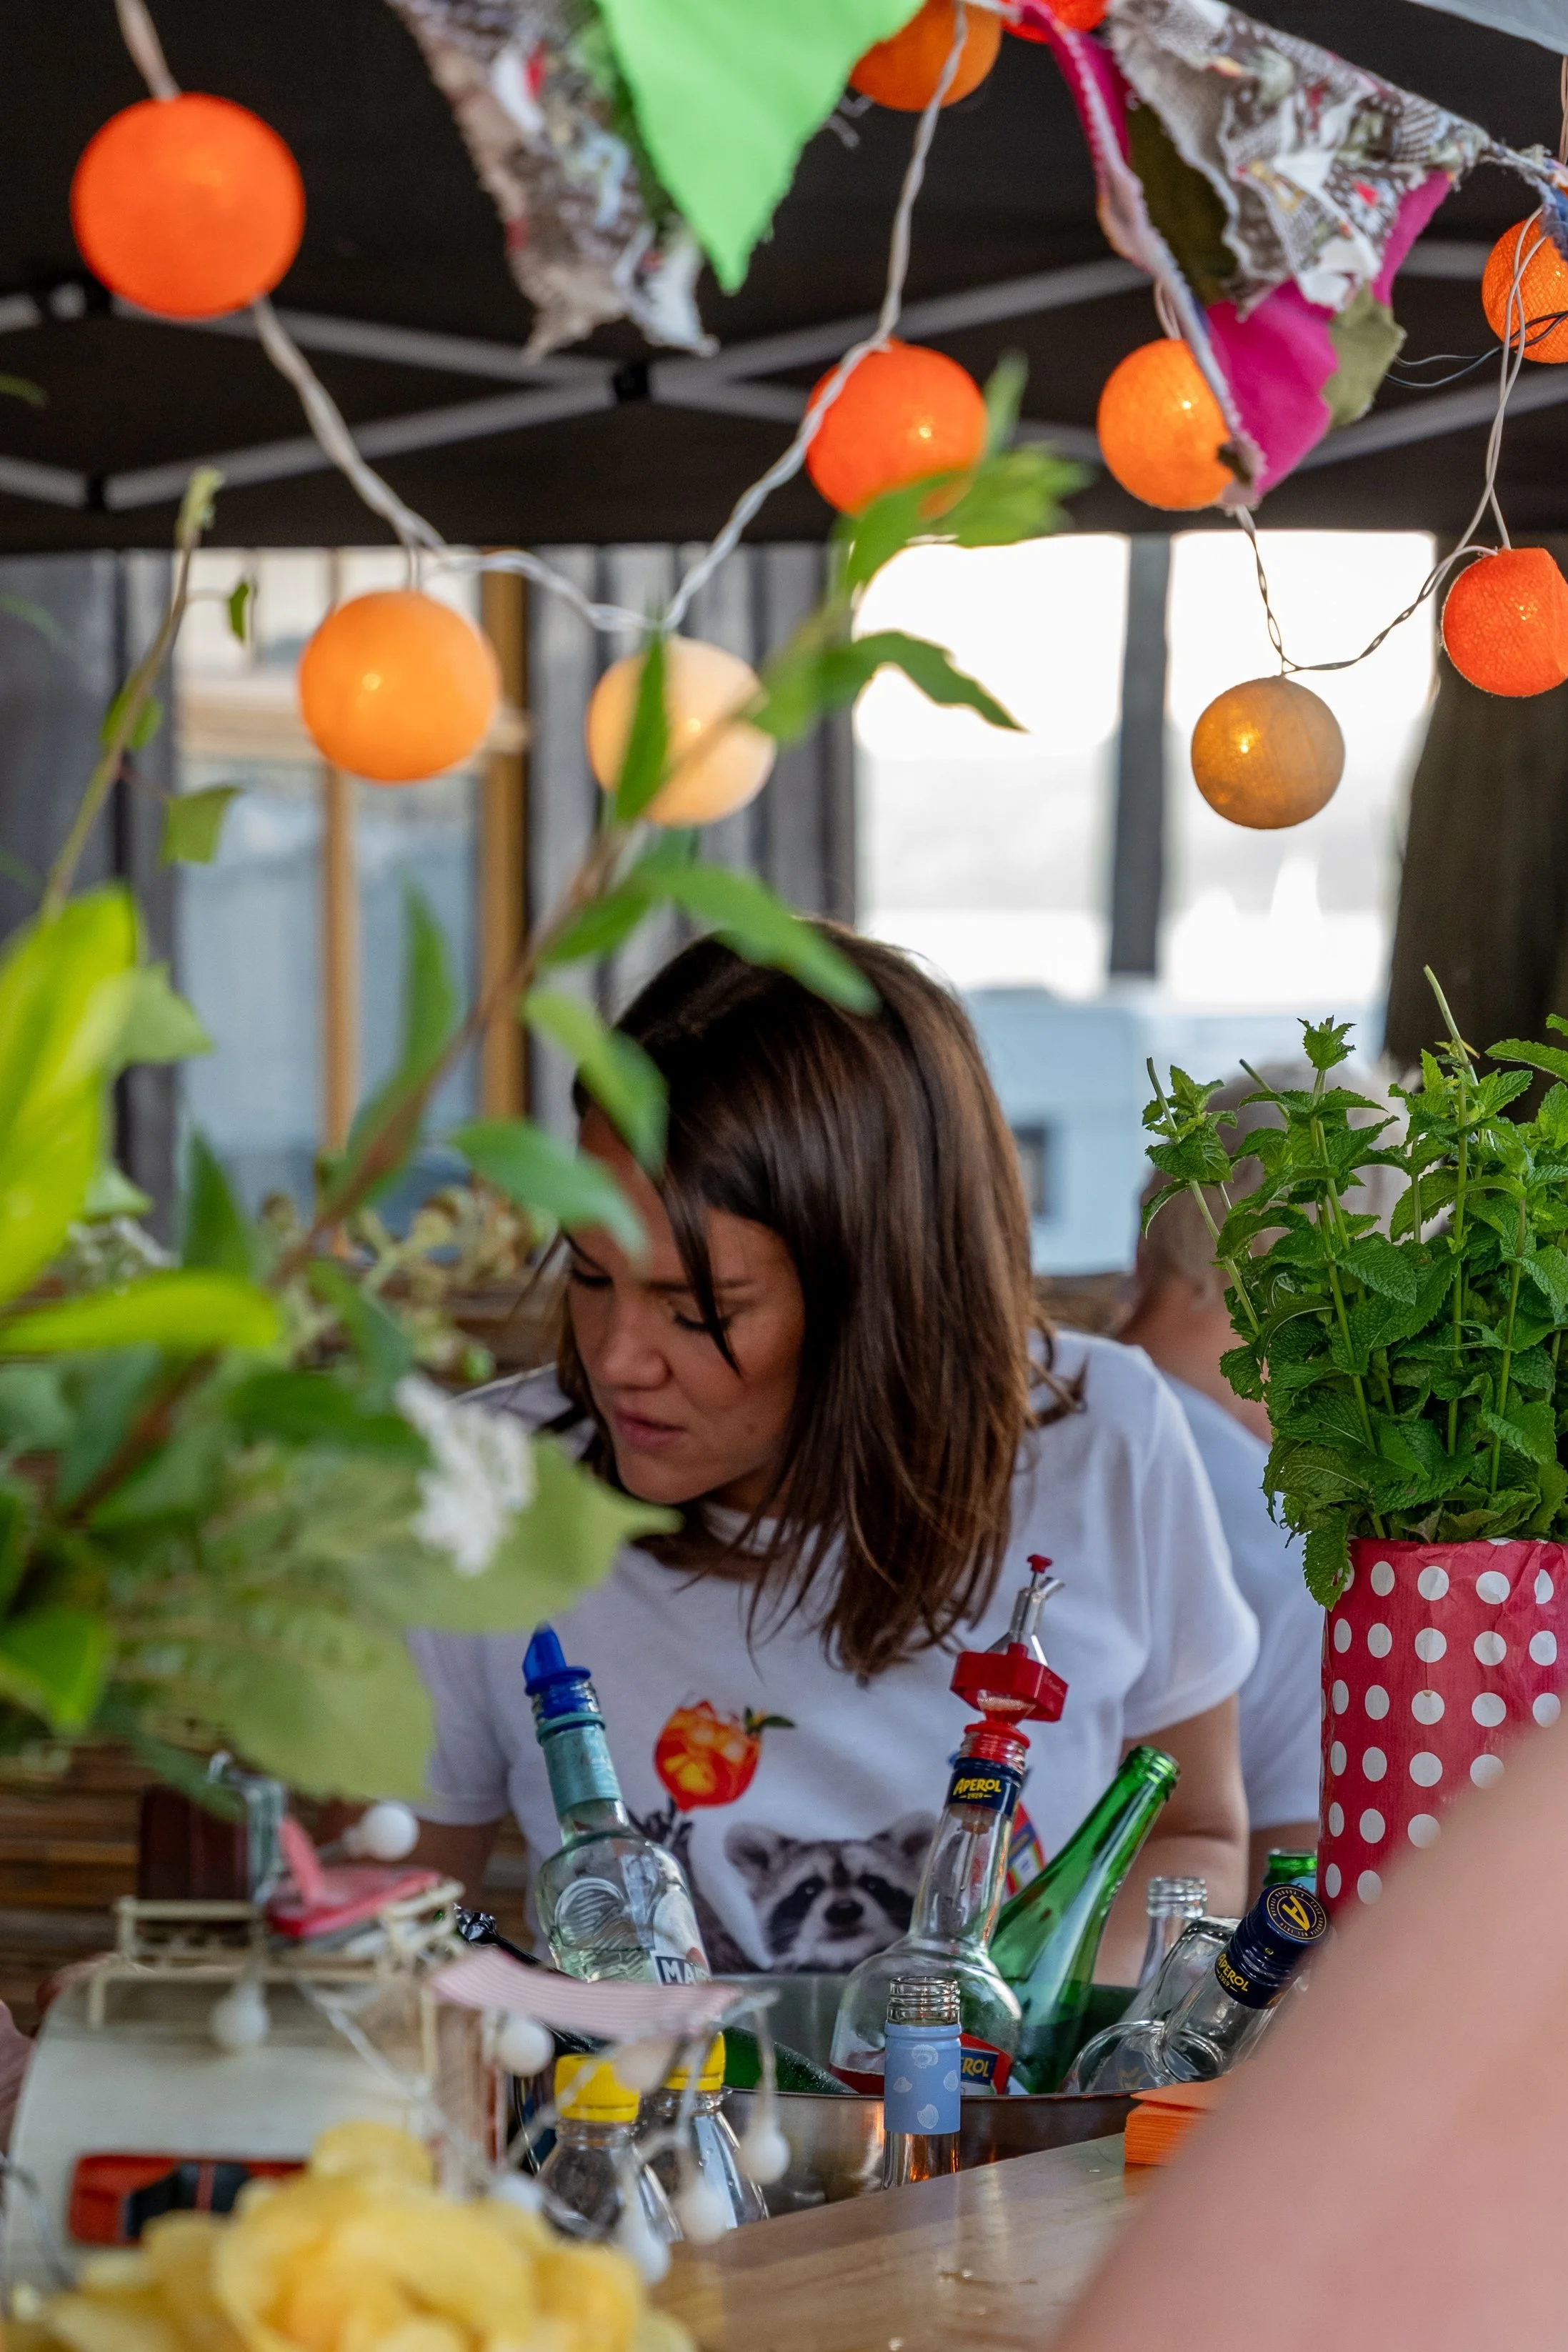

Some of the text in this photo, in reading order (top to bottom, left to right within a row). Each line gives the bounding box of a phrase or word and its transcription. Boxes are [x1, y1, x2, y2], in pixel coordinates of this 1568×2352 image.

[953, 1778, 1001, 1795] APEROL
[1282, 1895, 1310, 1931] A
[1217, 1953, 1249, 1992] APEROL
[962, 2057, 989, 2078] ROL
